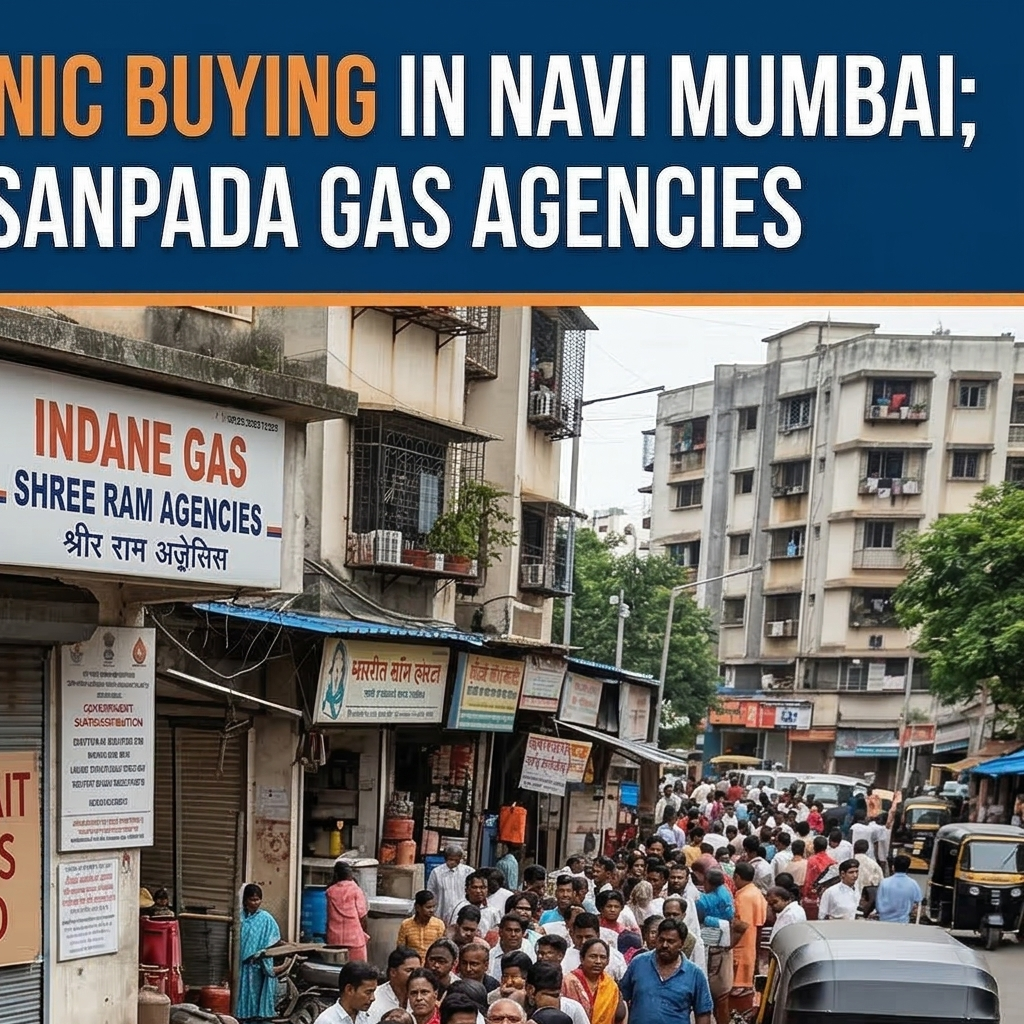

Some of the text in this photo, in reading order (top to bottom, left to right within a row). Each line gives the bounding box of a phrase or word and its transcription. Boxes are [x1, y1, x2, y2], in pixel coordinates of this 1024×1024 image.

[34, 398, 172, 477] INDANE
[183, 426, 248, 488] GAS
[14, 468, 263, 537] SHREE RAM AGENCIES
[111, 536, 148, 562] राम
